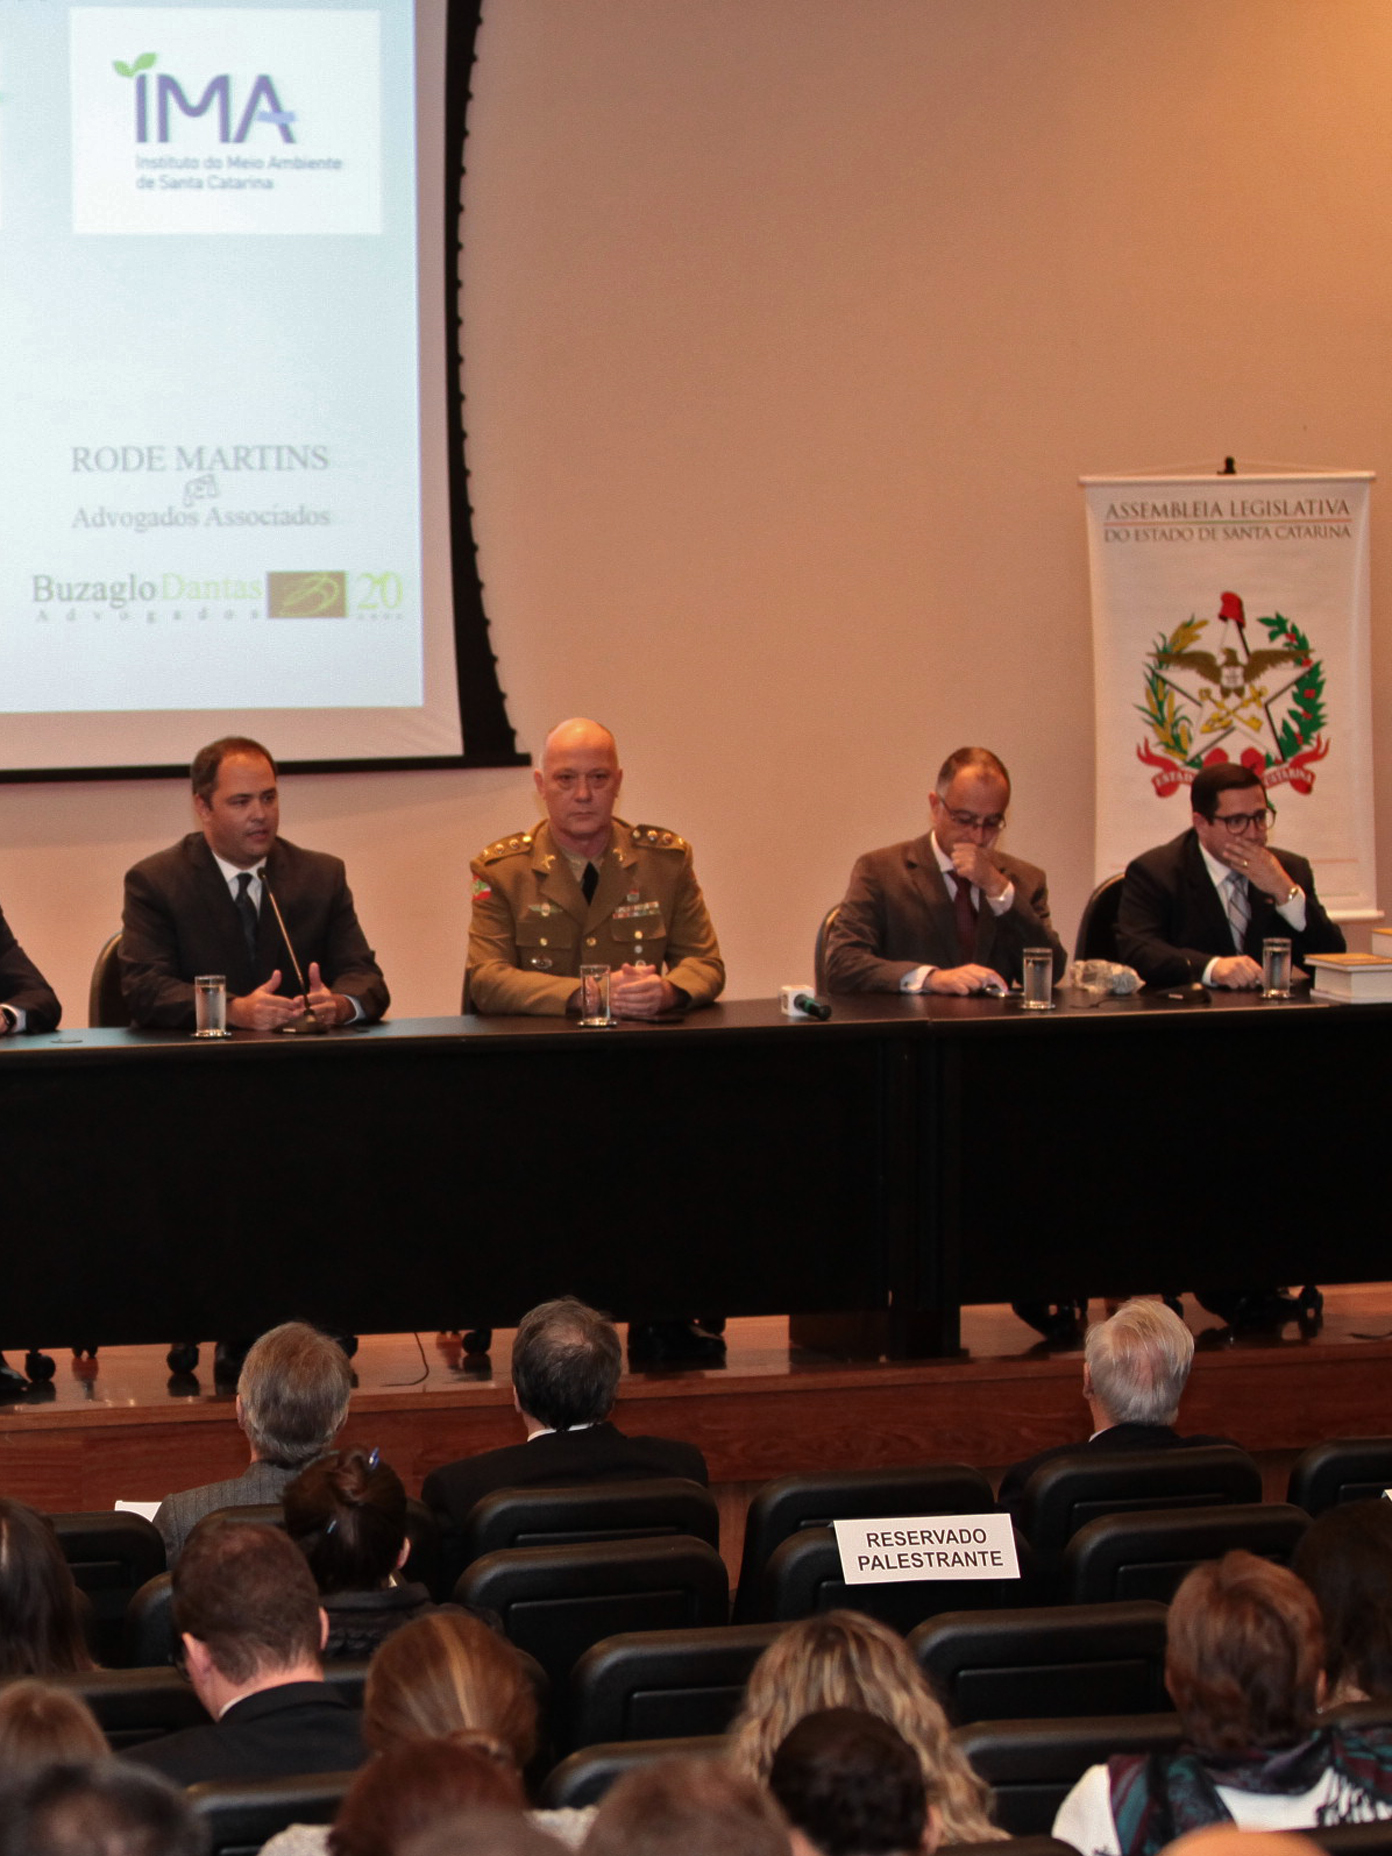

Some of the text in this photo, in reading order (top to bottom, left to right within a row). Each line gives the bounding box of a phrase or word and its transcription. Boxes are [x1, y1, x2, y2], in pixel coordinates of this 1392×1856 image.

[135, 74, 298, 144] IMA
[136, 153, 343, 171] Instituto do Meio Ambiente
[136, 174, 274, 190] de Santa Catarina
[71, 445, 329, 472] RODE MARTINS
[71, 504, 331, 533] Advogados Associados
[1106, 498, 1350, 519] ASSEMBLEIA LEGISLATIVA
[1104, 523, 1352, 543] DO ESTADO DE SANTA CATARINA
[357, 571, 404, 609] 20
[866, 1528, 987, 1547] RESERVADO
[858, 1550, 1004, 1571] PALESTRANTE
